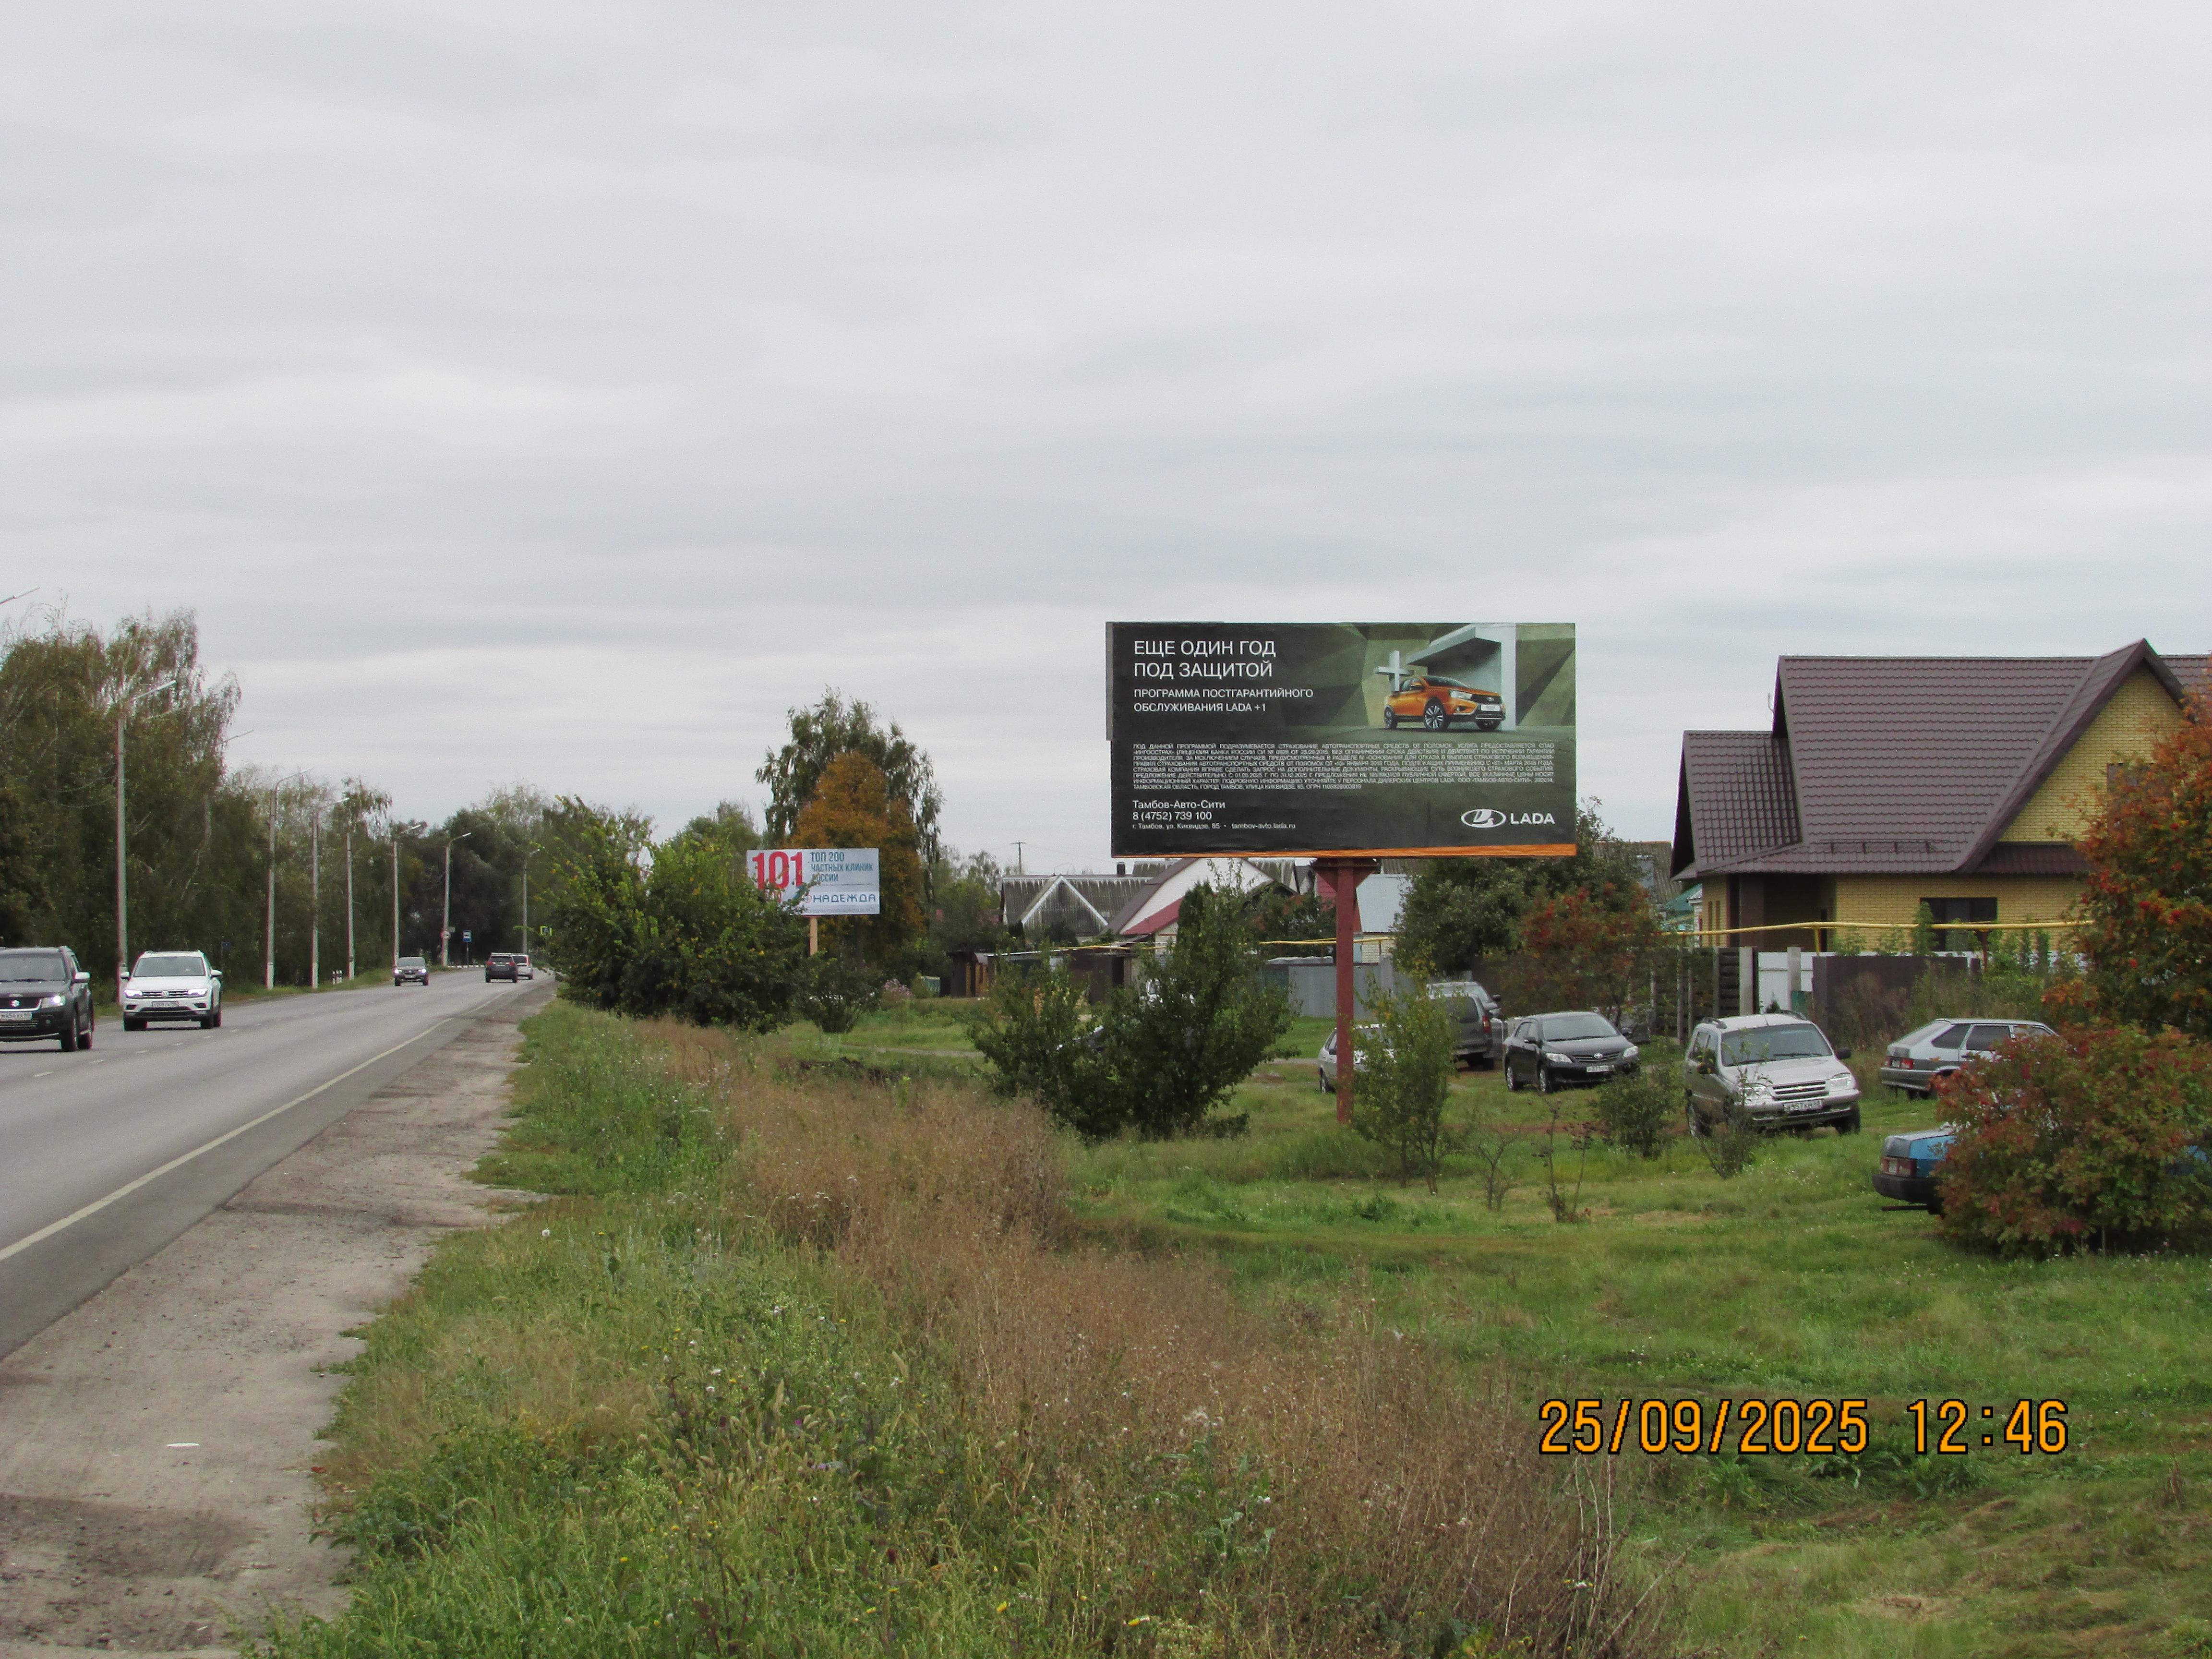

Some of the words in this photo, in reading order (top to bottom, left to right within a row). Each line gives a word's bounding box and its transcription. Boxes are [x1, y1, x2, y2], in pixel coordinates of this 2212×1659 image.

[1134, 640, 1176, 658] ЕЩЕ
[1181, 640, 1233, 658] ОДИН
[1240, 640, 1276, 658] ГОД
[1134, 662, 1174, 680] ПОД
[1179, 660, 1273, 680] ЗАЩИТОЙ
[1134, 689, 1201, 698] ПРОГРАММА
[1202, 688, 1314, 698] ПОСТГАРАНТИЙНОГО
[1134, 703, 1224, 712] ОБСЛУЖИВАНИЯ
[1226, 703, 1252, 712] LADA
[1254, 703, 1266, 712] +1
[1132, 800, 1226, 809] Тамбов-Авто-Сити
[1132, 812, 1139, 820] 8
[1141, 811, 1172, 822] (4752)
[1175, 812, 1192, 820] 739
[1195, 812, 1212, 820] 100
[1510, 813, 1556, 825] LADA
[810, 852, 827, 862] ТОП
[829, 852, 845, 862] 200
[752, 851, 803, 890] 101
[811, 863, 844, 872] ЧАСТНЫХ
[845, 863, 874, 872] КЛИНИК
[813, 894, 876, 903] НАДЕЖДА
